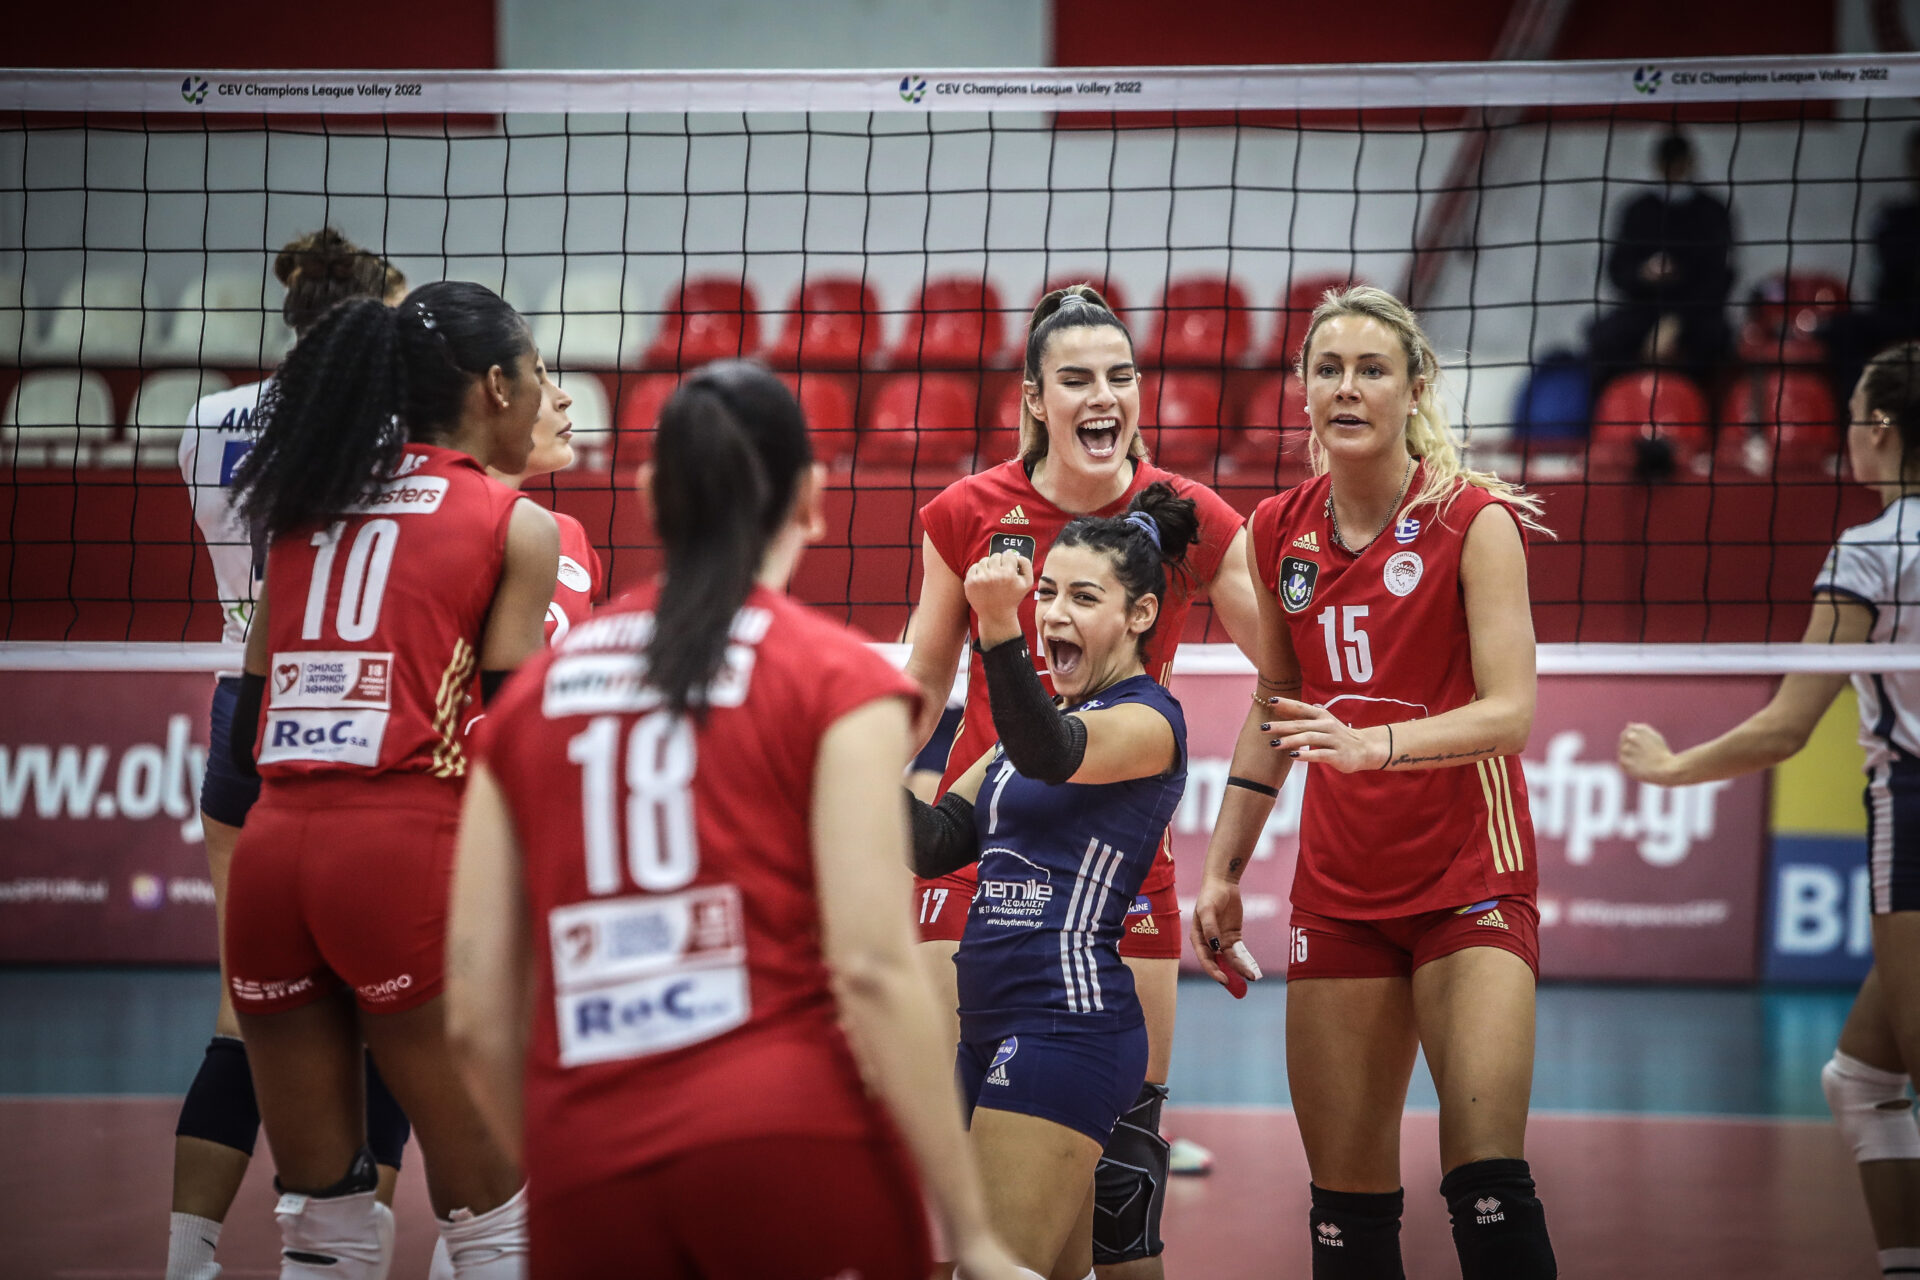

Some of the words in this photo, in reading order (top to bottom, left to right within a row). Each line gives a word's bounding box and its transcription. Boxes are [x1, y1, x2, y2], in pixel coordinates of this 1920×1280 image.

[1672, 72, 1697, 84] CEV
[1700, 71, 1767, 85] Champions
[1771, 70, 1815, 84] League
[1818, 68, 1855, 83] Volley
[1859, 68, 1888, 80] 2022
[218, 84, 242, 96] CEV
[245, 84, 309, 98] Champions
[313, 84, 354, 98] League
[357, 84, 391, 98] Volley
[395, 84, 422, 96] 2022
[936, 83, 960, 95] CEV
[963, 82, 1027, 97] Champions
[1031, 82, 1072, 96] League
[1076, 81, 1111, 95] Volley
[1114, 81, 1141, 93] 2022
[1000, 516, 1029, 525] adidas
[1003, 537, 1023, 547] CEV
[1292, 540, 1320, 552] adidas
[1292, 562, 1310, 572] CEV
[302, 518, 400, 642] 10
[1317, 604, 1374, 684] 15
[272, 720, 353, 747] RaC
[566, 715, 699, 895] 18
[919, 888, 949, 924] 17
[1001, 899, 1045, 908] ΑΣΦΑΛΙΣΗ
[991, 905, 1042, 916] ΧΙΛΙΟΜΕΤΡΟ
[1131, 926, 1159, 935] adidas
[1476, 918, 1509, 930] adidas
[1290, 926, 1308, 963] 15
[986, 1076, 1010, 1086] adidas
